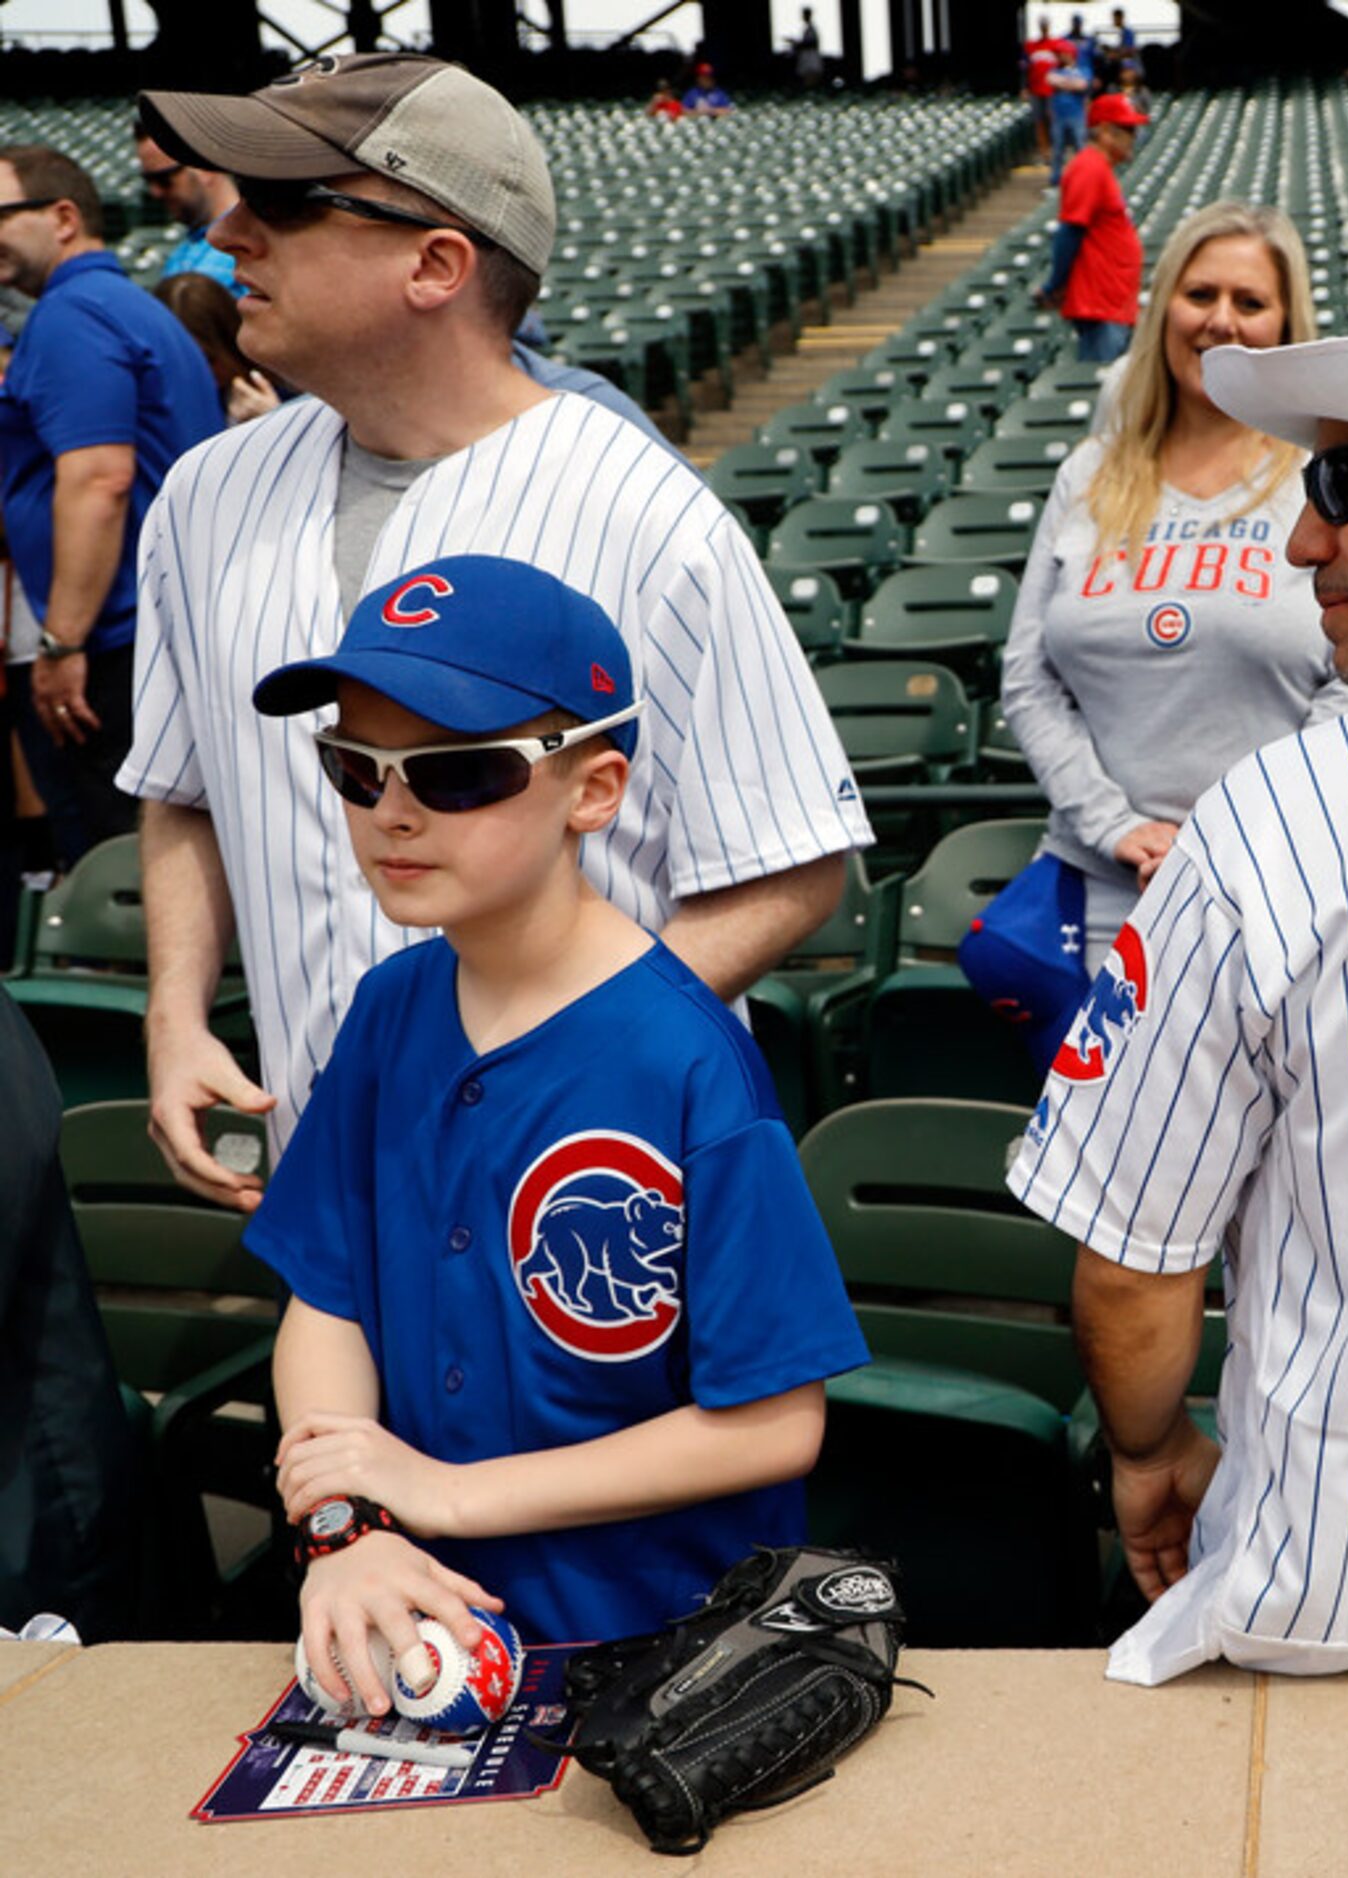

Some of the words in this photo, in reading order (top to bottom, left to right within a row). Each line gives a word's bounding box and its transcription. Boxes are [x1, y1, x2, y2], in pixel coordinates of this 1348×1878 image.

[1146, 518, 1271, 542] ICAGO
[1080, 543, 1274, 600] CUBS
[382, 573, 455, 628] C
[474, 1703, 530, 1789] SCHEDULE
